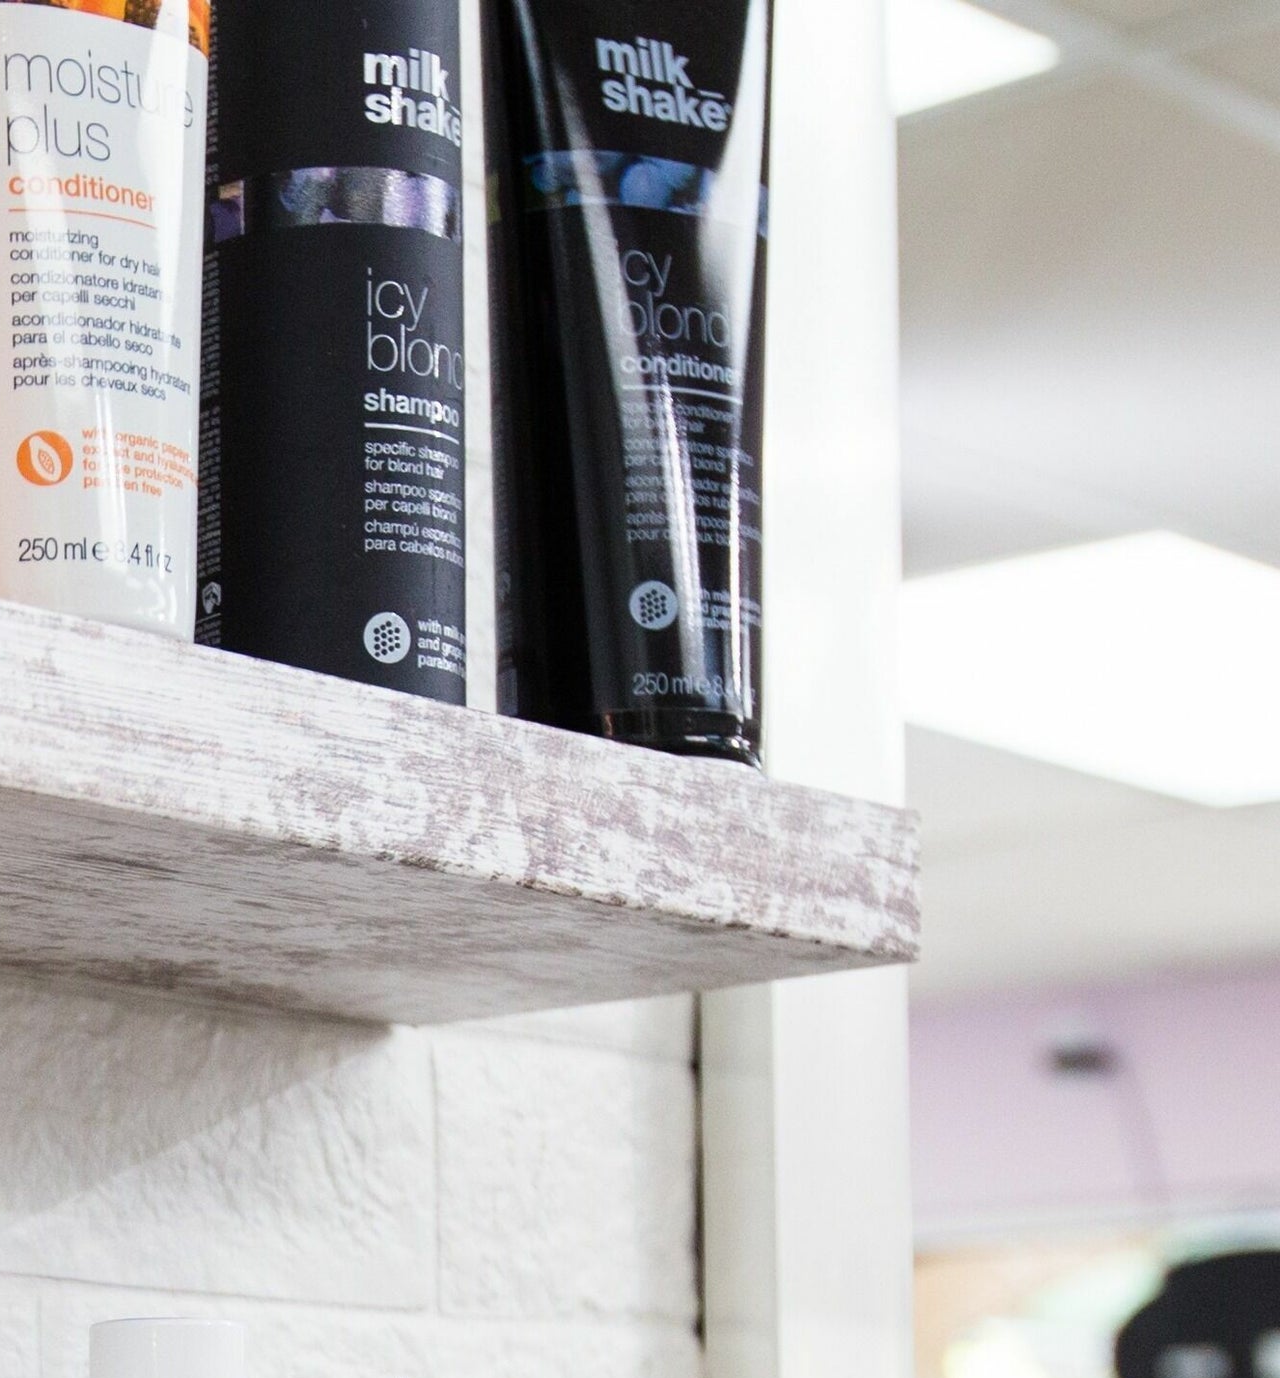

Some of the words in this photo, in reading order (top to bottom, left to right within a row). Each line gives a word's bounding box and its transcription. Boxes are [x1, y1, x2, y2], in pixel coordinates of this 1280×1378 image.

[600, 75, 729, 132] shake
[7, 104, 111, 167] plus
[97, 251, 117, 267] for
[119, 256, 141, 275] dry
[11, 290, 38, 306] per
[93, 294, 137, 312] secchi
[367, 266, 429, 332] icy
[11, 332, 48, 348] para
[69, 332, 121, 349] cabello
[124, 338, 154, 356] seco
[620, 352, 739, 387] conditione
[13, 374, 50, 391] pour
[80, 374, 138, 393] cheveux
[363, 387, 460, 428] shampoo
[133, 450, 156, 464] and
[364, 441, 416, 459] specific
[364, 457, 384, 472] for
[387, 457, 425, 475] blond
[364, 480, 427, 499] shampoo
[364, 497, 388, 513] per
[391, 499, 431, 516] capelli
[19, 537, 58, 562] 250
[64, 537, 88, 561] ml
[364, 537, 397, 552] para
[417, 618, 442, 635] with
[417, 635, 440, 652] and
[632, 673, 669, 696] 250
